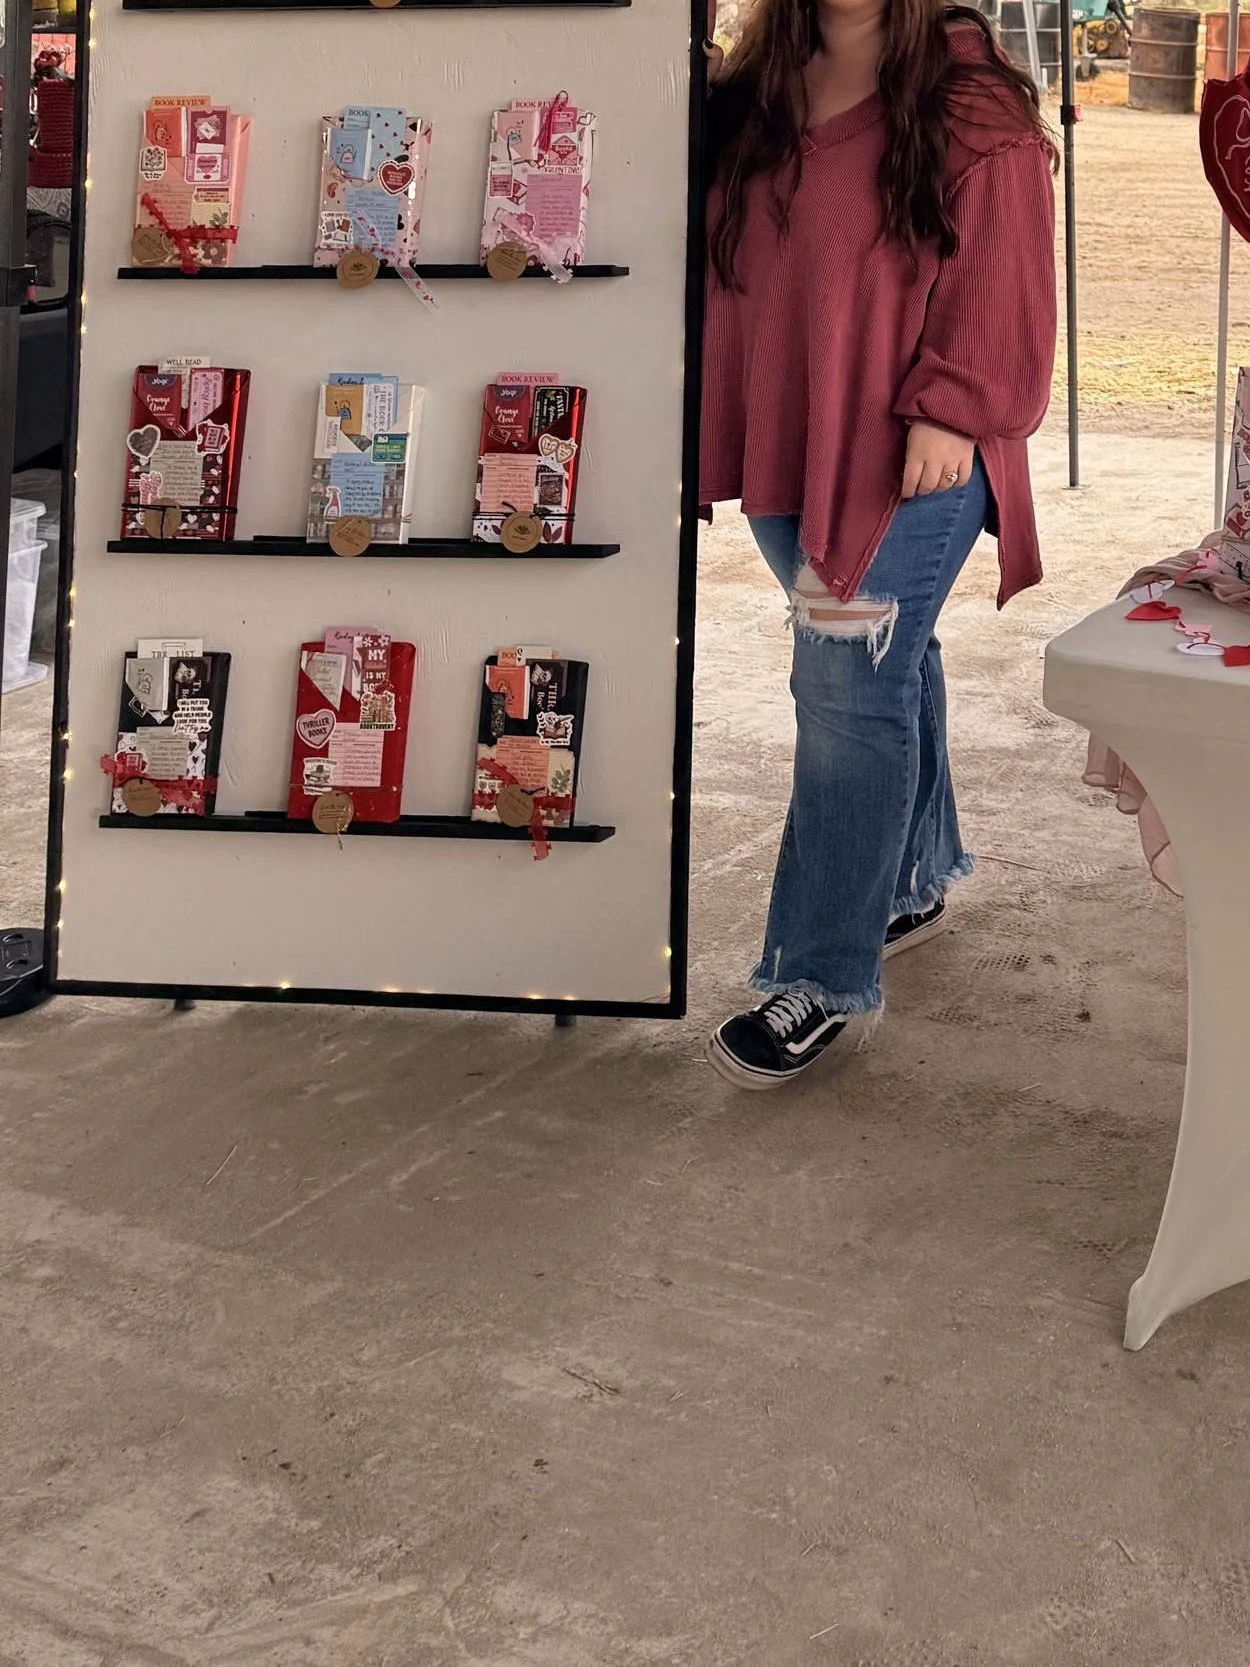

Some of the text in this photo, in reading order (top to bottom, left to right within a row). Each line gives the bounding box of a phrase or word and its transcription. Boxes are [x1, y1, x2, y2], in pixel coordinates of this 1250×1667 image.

[154, 99, 207, 107] BOOK REVIEW
[515, 101, 537, 109] BOOK
[348, 109, 369, 117] BOOK
[166, 358, 183, 366] WELL
[501, 375, 554, 384] BOOK REVIEW
[501, 389, 517, 397] yogi
[147, 394, 171, 405] Orange
[495, 405, 519, 417] Orange
[152, 650, 195, 658] TBR LIST
[368, 649, 386, 661] MY
[501, 651, 516, 659] BOO
[366, 672, 387, 680] IS MY
[302, 716, 330, 729] THRILLER
[308, 728, 328, 738] BOOKS
